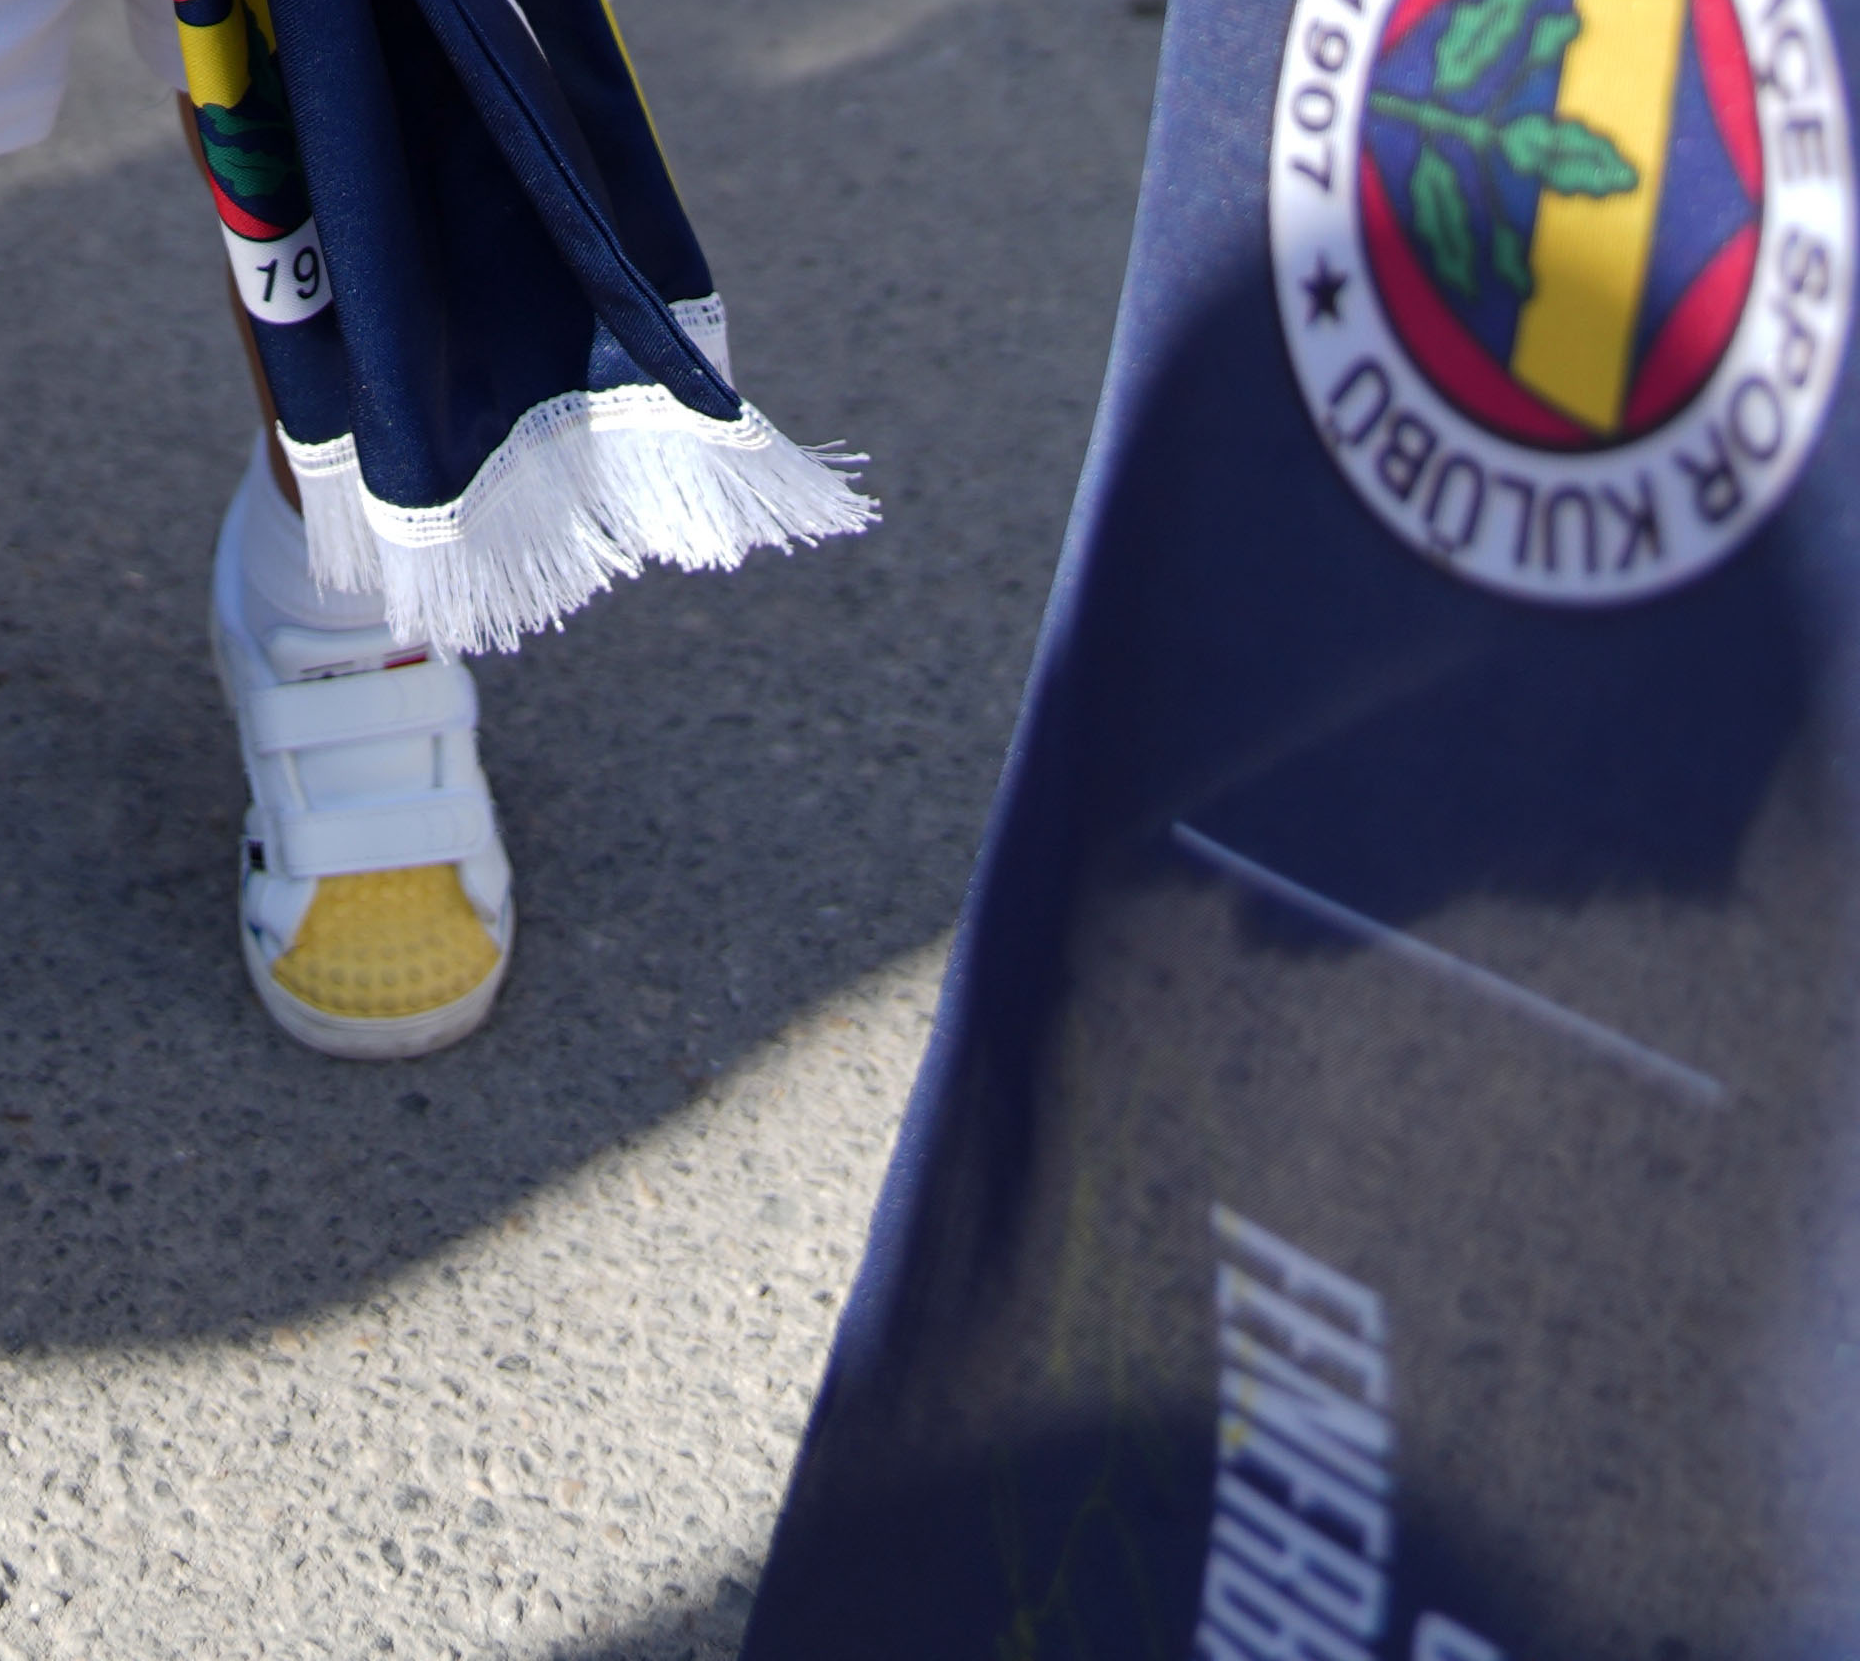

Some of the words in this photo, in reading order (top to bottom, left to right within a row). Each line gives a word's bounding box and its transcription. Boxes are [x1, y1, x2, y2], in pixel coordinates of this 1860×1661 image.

[1325, 355, 1668, 576] KULÜBÜ
[1690, 230, 1831, 530] SPOR
[1195, 1200, 1390, 1661] FENERB
